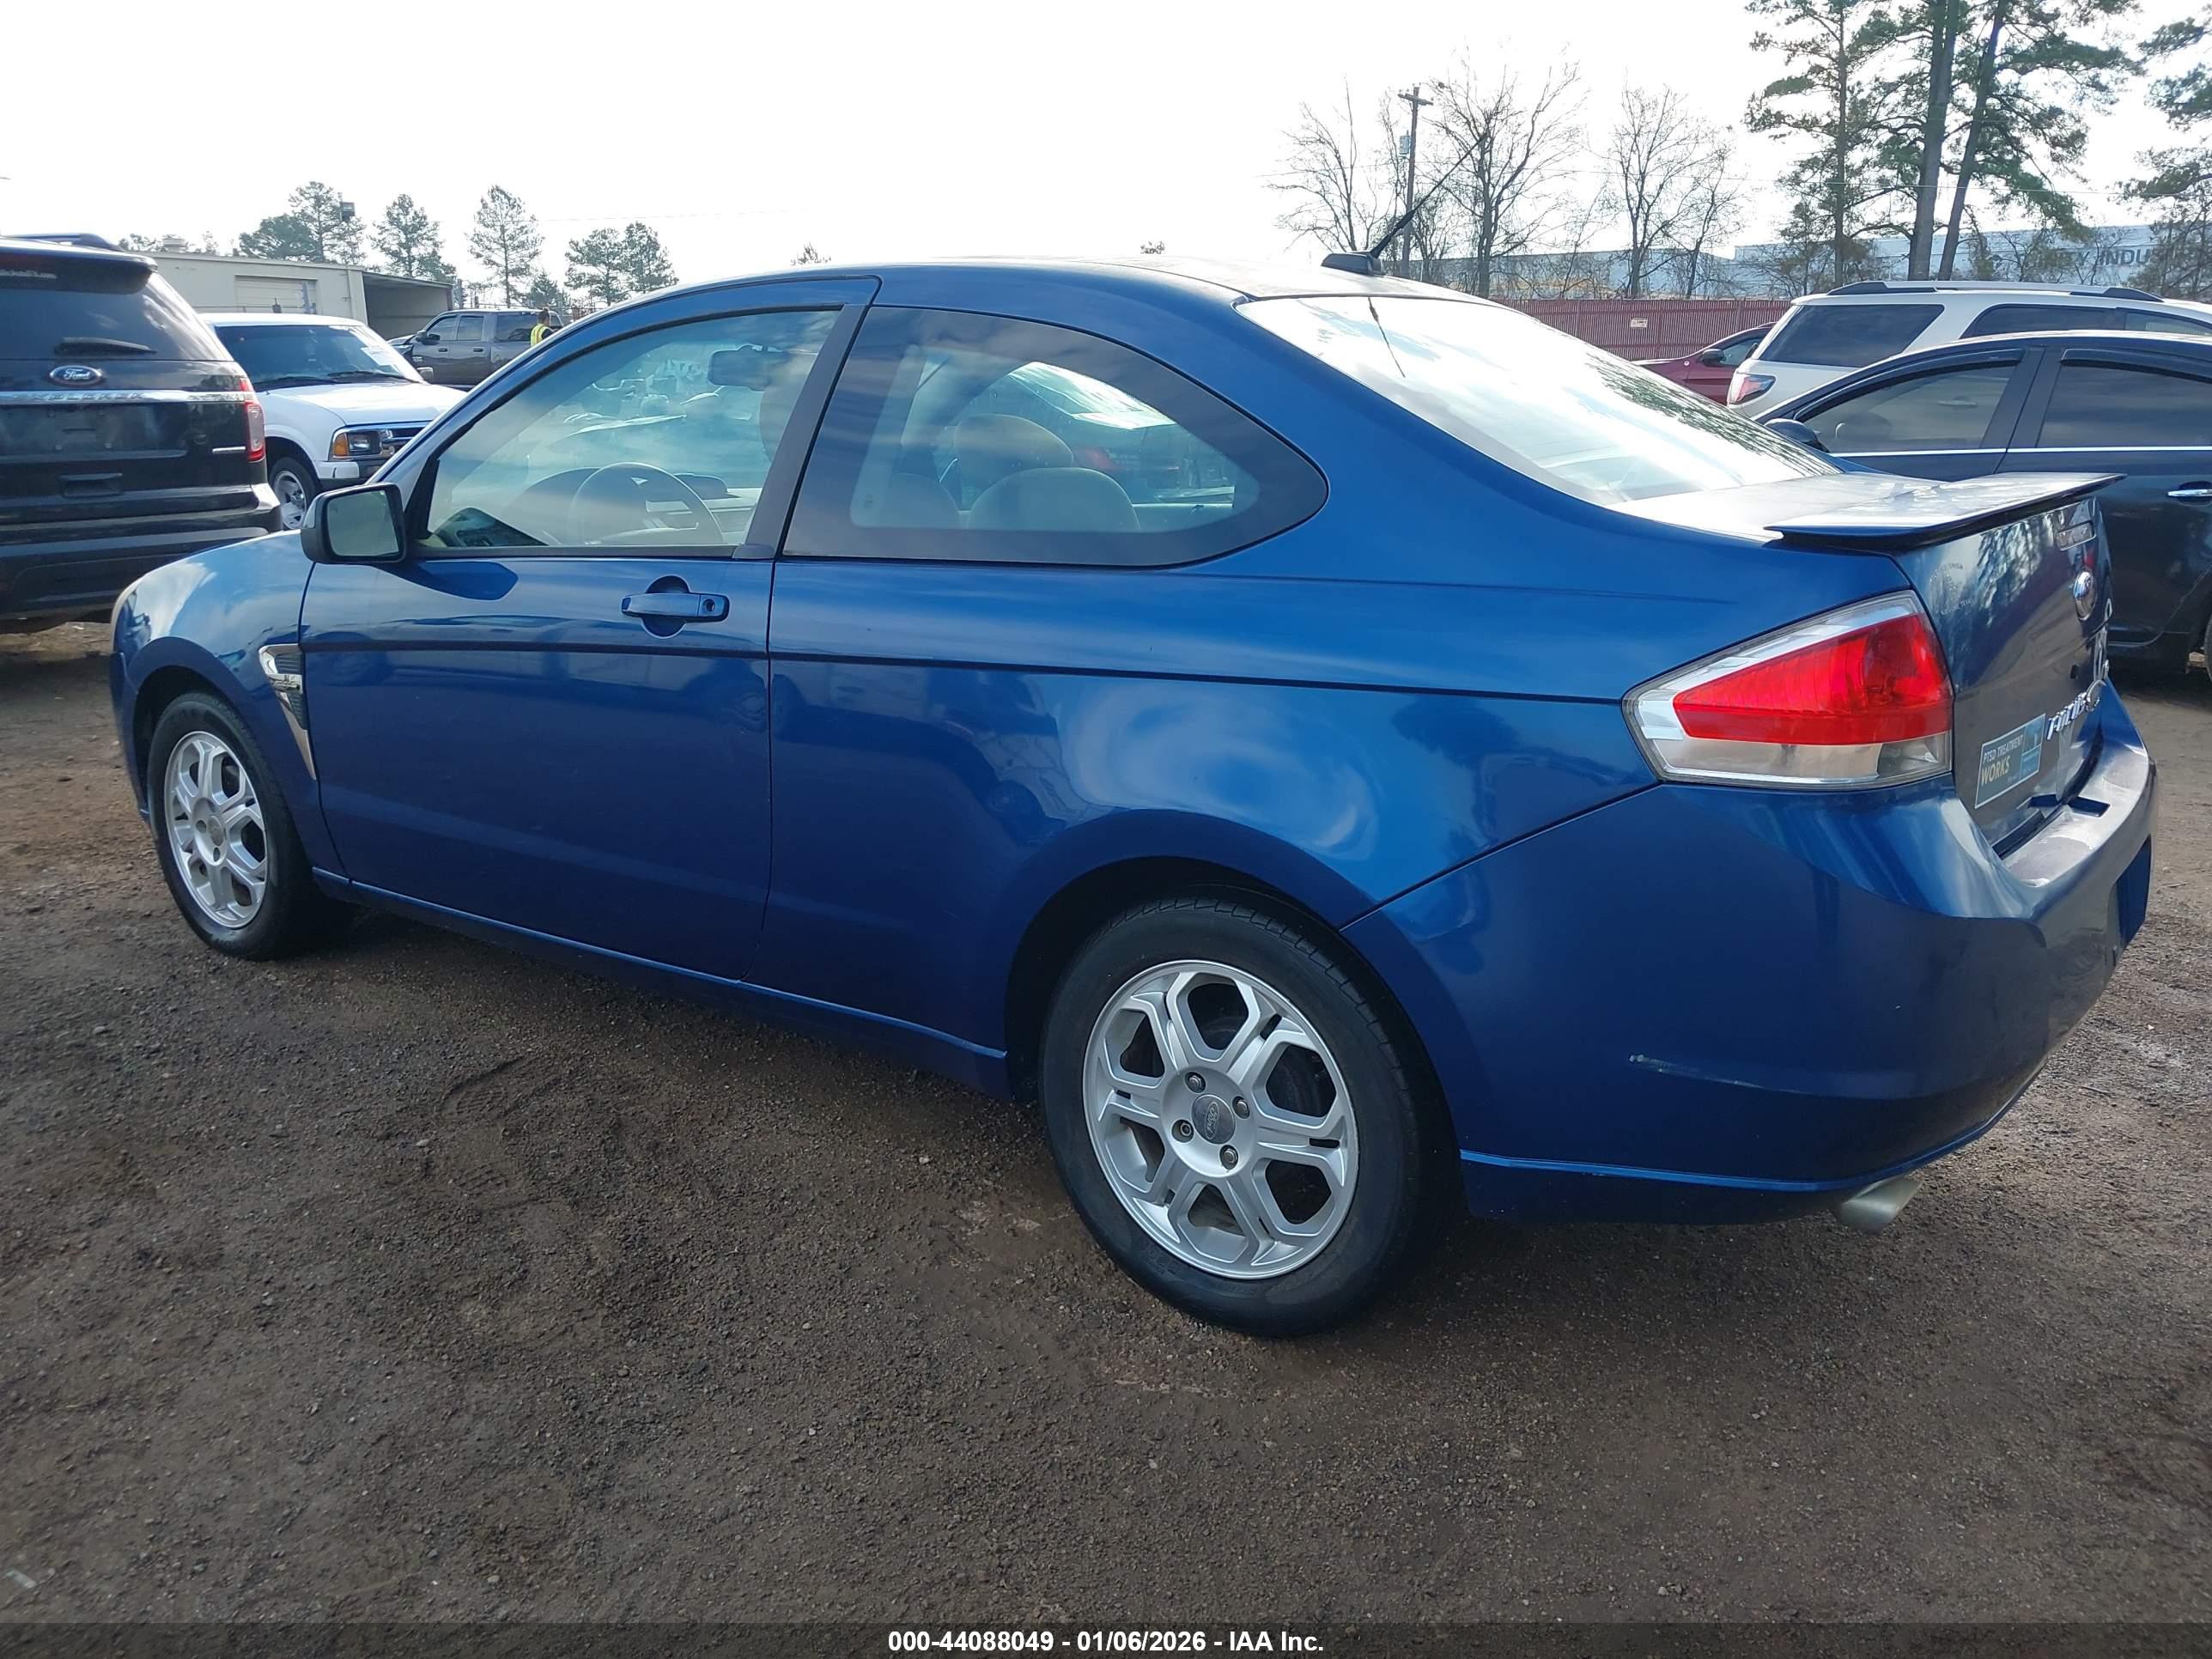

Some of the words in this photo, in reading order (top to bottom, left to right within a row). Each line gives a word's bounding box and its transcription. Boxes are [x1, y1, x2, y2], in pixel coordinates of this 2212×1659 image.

[2100, 248, 2151, 265] INDU
[64, 368, 90, 380] Ford
[14, 393, 144, 402] XPLORER
[1983, 748, 1996, 764] PTSD
[1997, 734, 2024, 758] TREATMENT
[1981, 755, 2011, 787] WORKS
